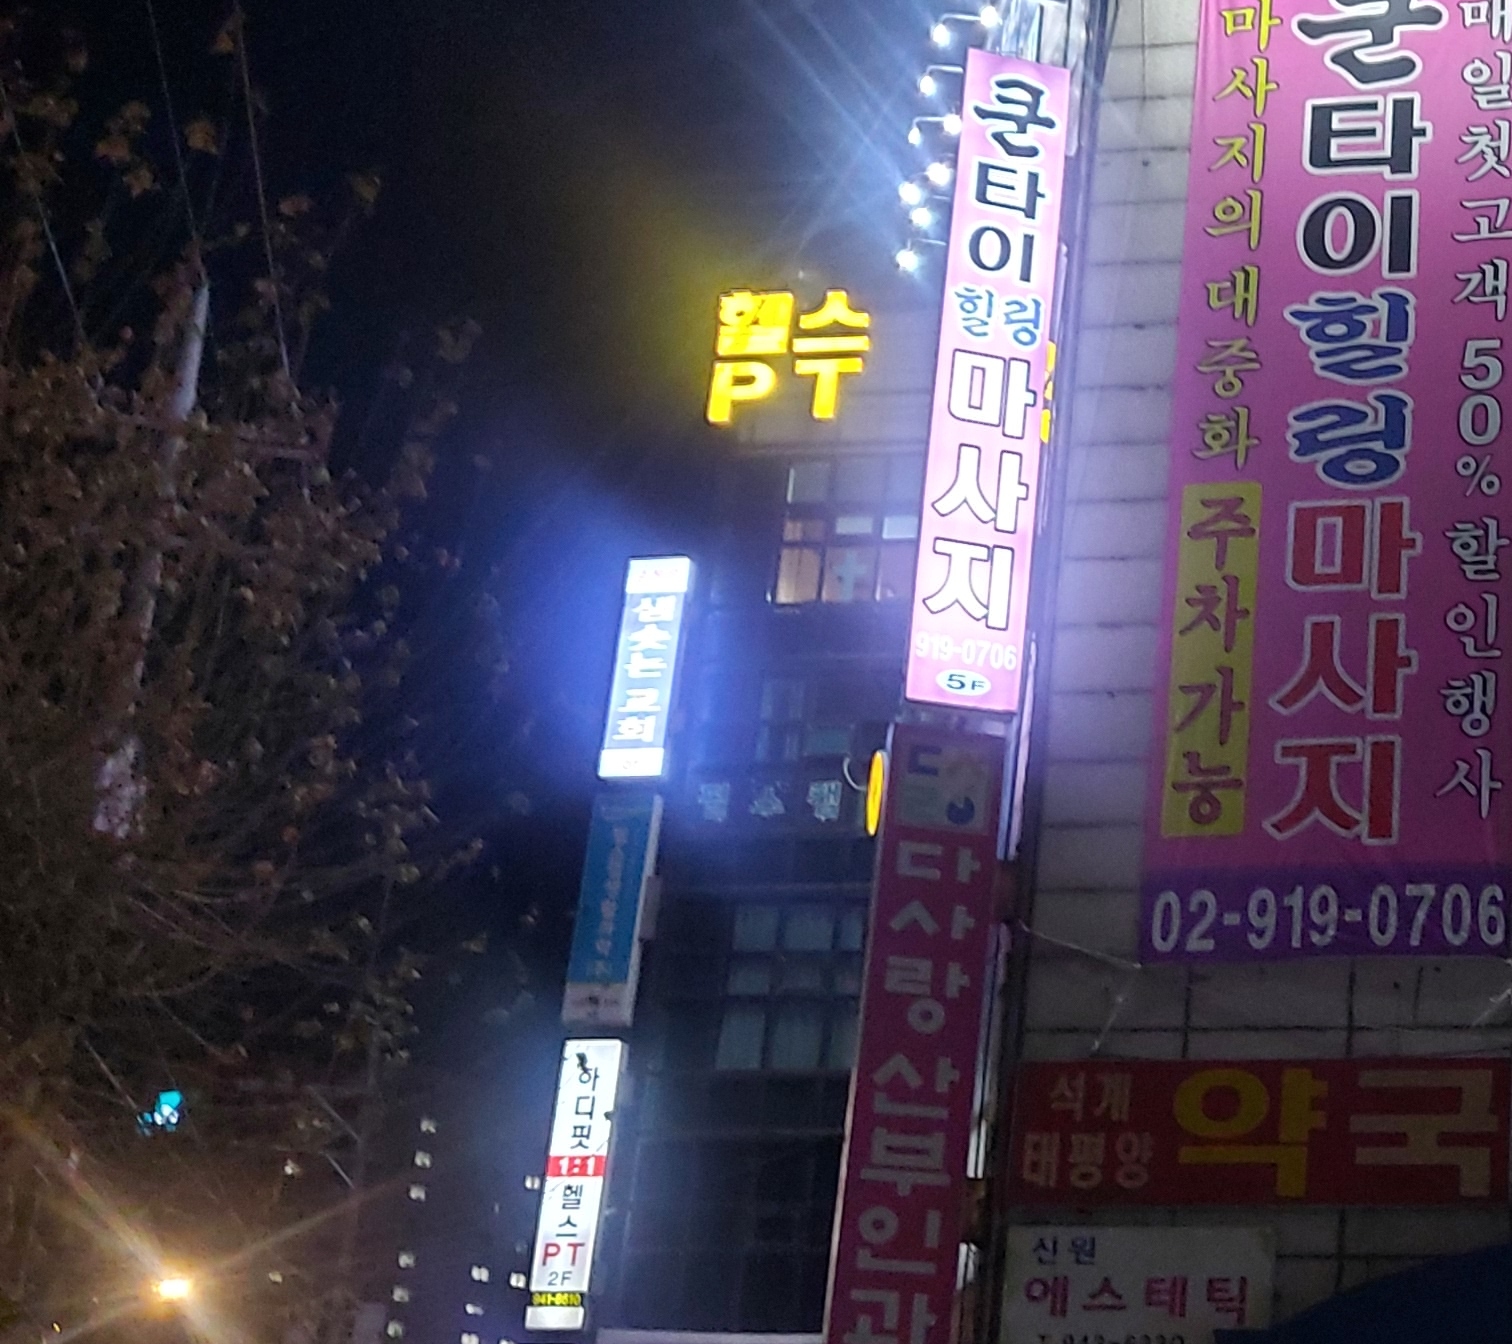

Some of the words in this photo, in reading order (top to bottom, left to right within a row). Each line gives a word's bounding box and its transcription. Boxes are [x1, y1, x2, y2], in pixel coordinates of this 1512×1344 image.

[968, 76, 1058, 284] 쿤타이
[716, 288, 871, 356] 헬스
[954, 286, 1043, 346] 힐링
[706, 356, 864, 425] PT
[922, 348, 1038, 632] 마사지
[915, 631, 1017, 672] 919-0706
[1170, 496, 1258, 826] 주차가능
[945, 673, 988, 692] 5F
[612, 687, 662, 743] 교회
[1151, 883, 1506, 954] 02-919-0706
[1050, 1071, 1134, 1122] 석계
[1022, 1131, 1154, 1190] 태평양
[1174, 1067, 1499, 1198] 약국
[558, 1157, 596, 1175] 1:1
[554, 1183, 584, 1238] 헬스
[543, 1242, 585, 1266] PT
[548, 1271, 573, 1286] 2F
[1025, 1275, 1249, 1326] 에스테틱
